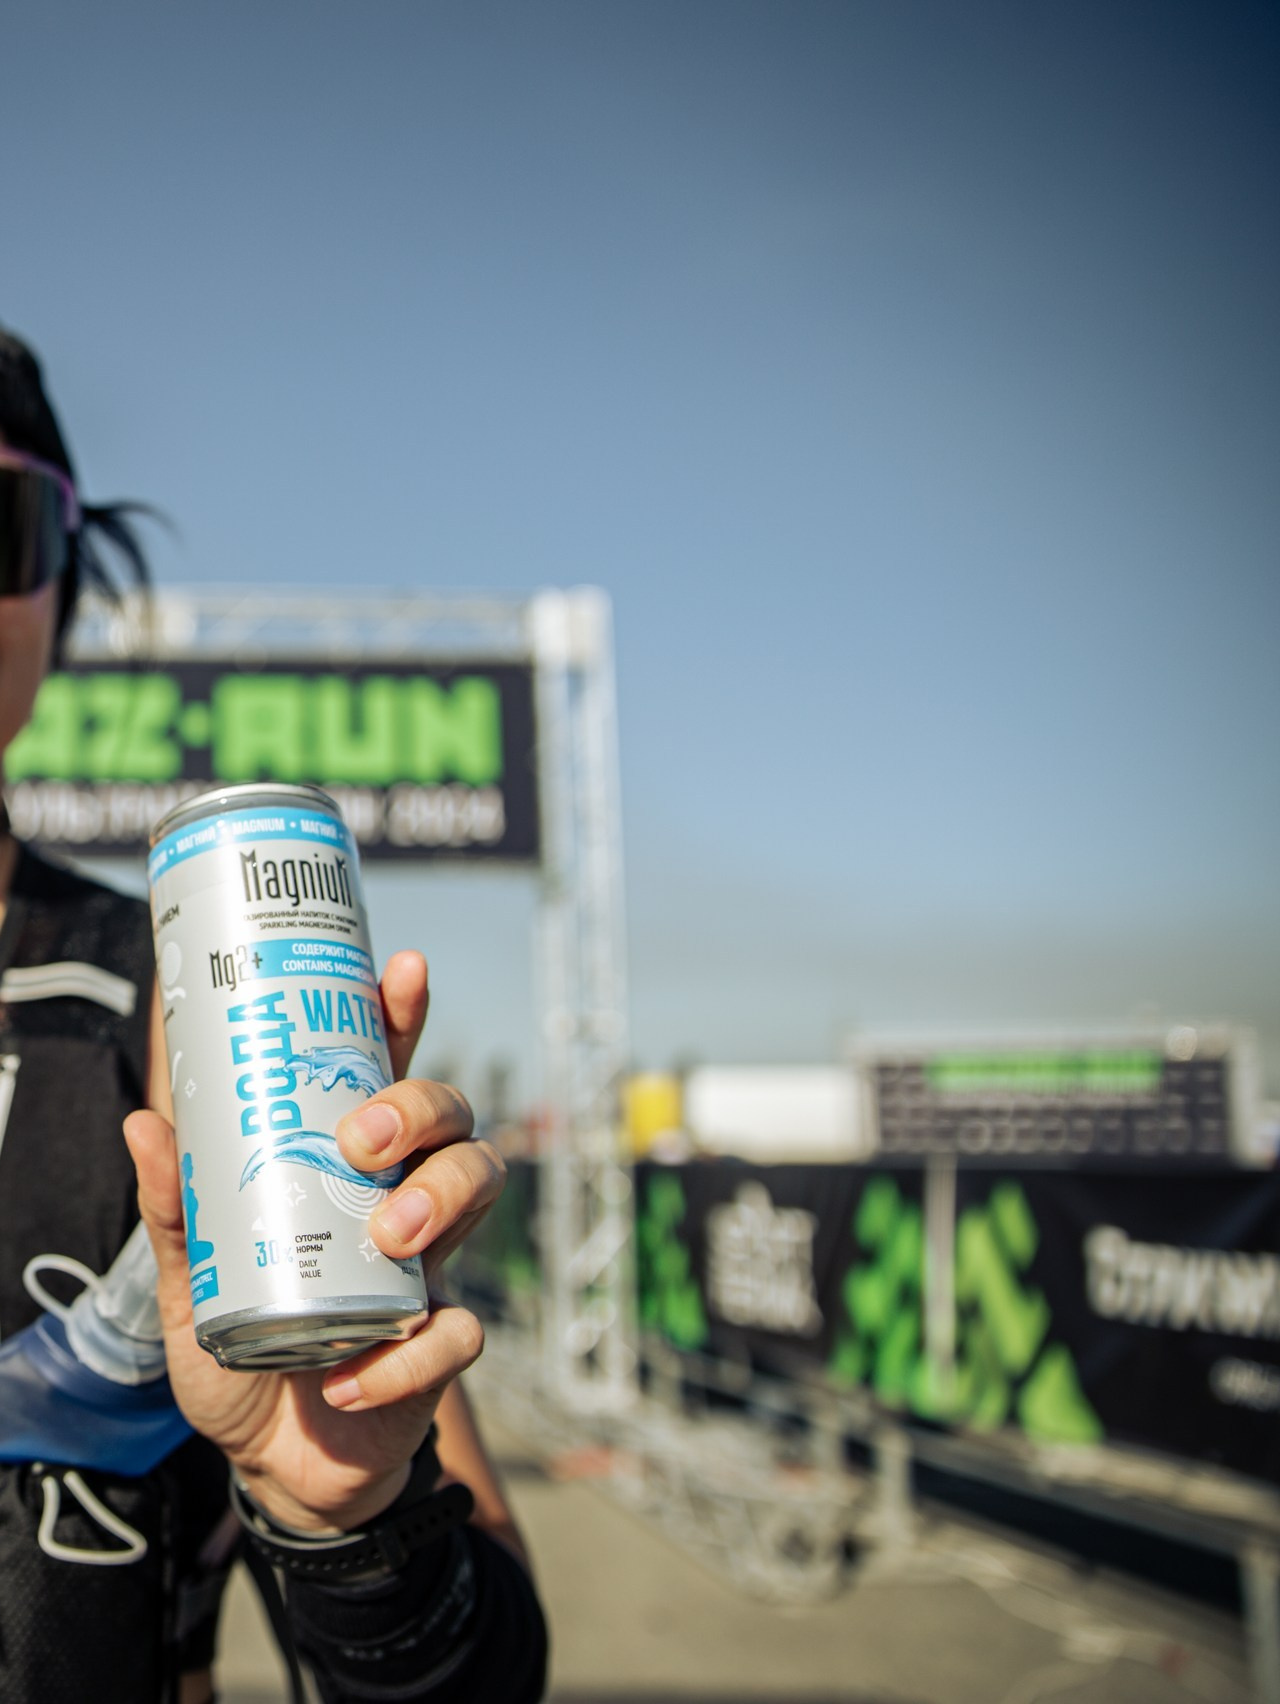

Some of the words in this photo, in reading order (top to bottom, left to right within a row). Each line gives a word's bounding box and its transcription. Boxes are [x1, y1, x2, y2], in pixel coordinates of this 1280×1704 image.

[212, 672, 502, 785] RUN
[232, 818, 286, 835] MAGNIUM
[259, 920, 297, 930] SPARKLING
[299, 920, 335, 931] MAGNESIUM
[292, 943, 345, 958] СОДЕРЖИТ
[282, 959, 333, 974] CONTAINS
[227, 990, 303, 1137] ВОДА
[295, 1230, 332, 1243] СУТОЧНОЙ
[296, 1243, 324, 1254] НОРМЫ
[299, 1258, 318, 1269] DAILY
[300, 1269, 322, 1279] VALUE
